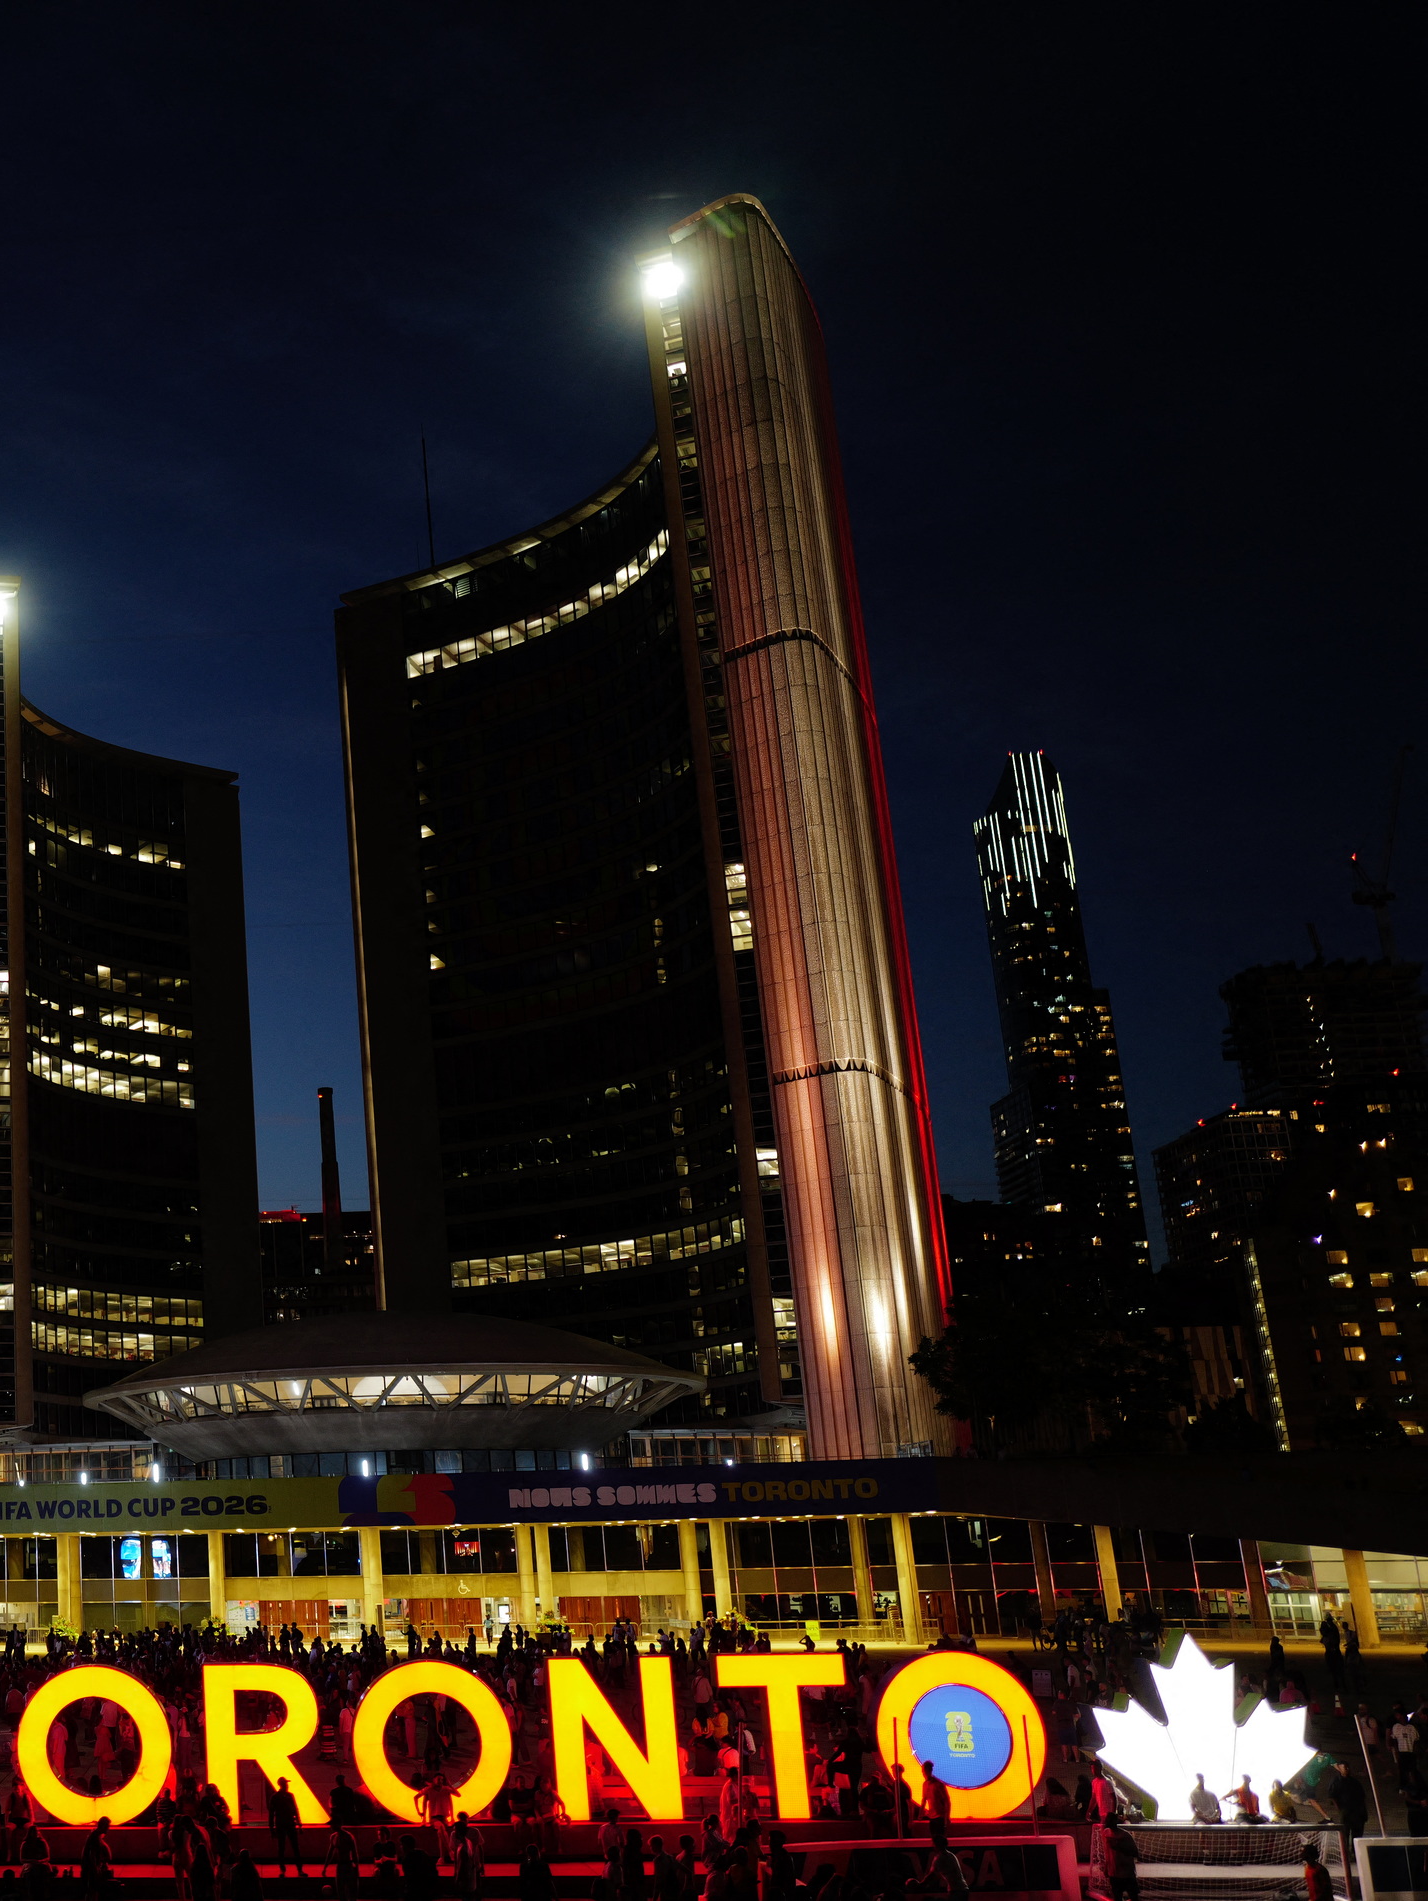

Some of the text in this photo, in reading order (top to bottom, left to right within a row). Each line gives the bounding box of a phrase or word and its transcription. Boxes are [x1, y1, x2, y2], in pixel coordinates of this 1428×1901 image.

[36, 1499, 122, 1520] WORLD
[127, 1498, 175, 1518] CUP
[180, 1494, 268, 1516] 2026
[509, 1477, 880, 1508] NOUS SOMMES TORONTO
[900, 1849, 1005, 1887] VSA
